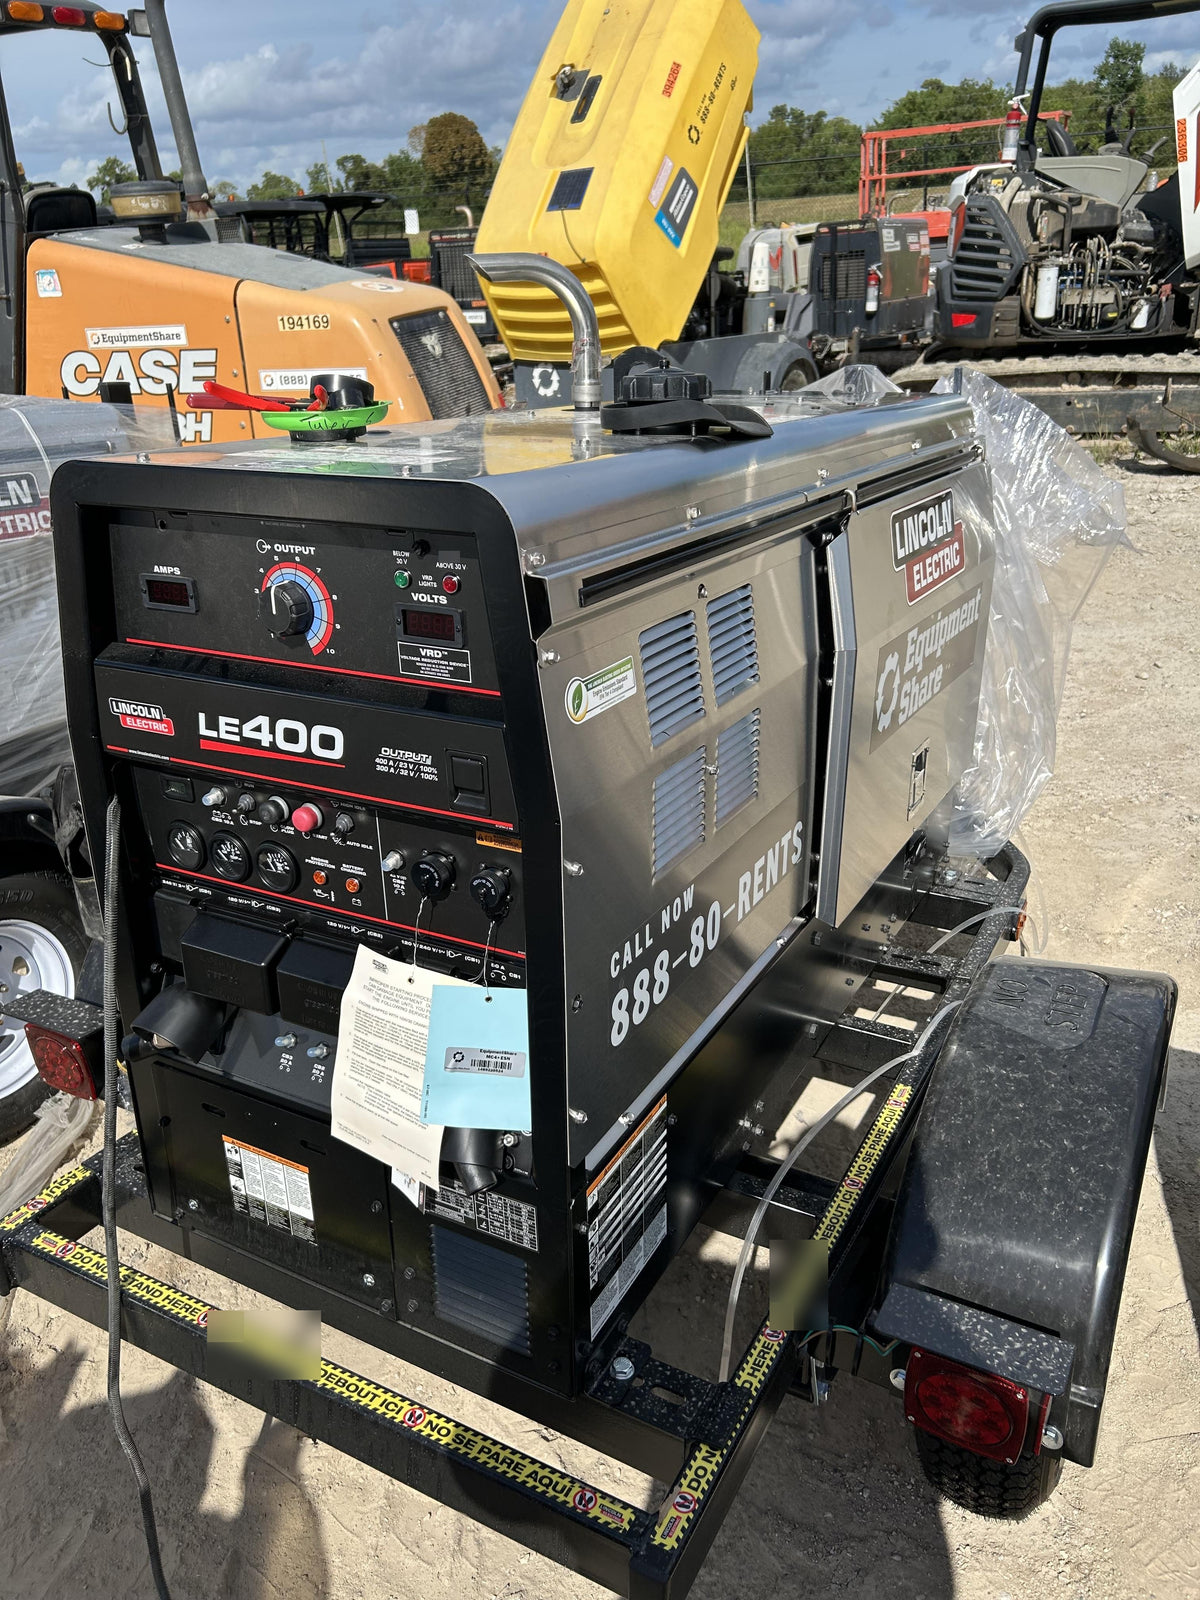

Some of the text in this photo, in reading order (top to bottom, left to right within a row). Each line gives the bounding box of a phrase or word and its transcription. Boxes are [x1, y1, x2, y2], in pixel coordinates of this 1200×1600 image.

[662, 61, 682, 98] 394264
[1177, 118, 1187, 162] 236306
[280, 315, 329, 330] 194169
[101, 331, 181, 345] EquipmentShare
[60, 348, 218, 396] CASE
[279, 374, 308, 386] (888)
[895, 499, 953, 560] LINCOLN
[273, 543, 316, 556] OUTPUT
[392, 550, 410, 558] BELOW
[153, 565, 181, 575] AMPS
[436, 562, 454, 570] ABOVE
[913, 541, 961, 592] ELECTRIC
[411, 592, 448, 604] VOLTS
[903, 588, 982, 675] Equipment
[421, 657, 448, 665] REDUCTION
[898, 664, 944, 726] Share
[112, 700, 160, 720] LINCOLN
[126, 717, 169, 733] ELECTRIC
[198, 712, 344, 760] LE400
[375, 757, 388, 765] 400
[399, 761, 408, 769] 23
[420, 766, 438, 774] 100%
[420, 773, 438, 781] 100%
[360, 842, 373, 850] IDLE
[305, 859, 336, 869] PROTECTION
[340, 866, 367, 876] CHARGING
[342, 863, 364, 872] BATTERY
[610, 883, 695, 978] CALL NOW
[610, 820, 803, 1047] 888-80-RENTS
[390, 985, 413, 998] STARTING
[381, 999, 408, 1013] FOLLOWING
[480, 1048, 517, 1056] EquipmentShare
[869, 1127, 887, 1150] PARE
[861, 1150, 875, 1164] SE
[856, 1163, 868, 1178] NO
[843, 1191, 854, 1203] ICI
[71, 1251, 202, 1317] DO STAND HERE
[750, 1340, 775, 1380] HERE
[379, 1398, 404, 1414] ICI
[423, 1419, 574, 1498] NO SE PARE AQUÍ
[687, 1467, 706, 1492] DO
[600, 1504, 622, 1518] LINCOLN
[661, 1516, 676, 1539] LINCOLN
